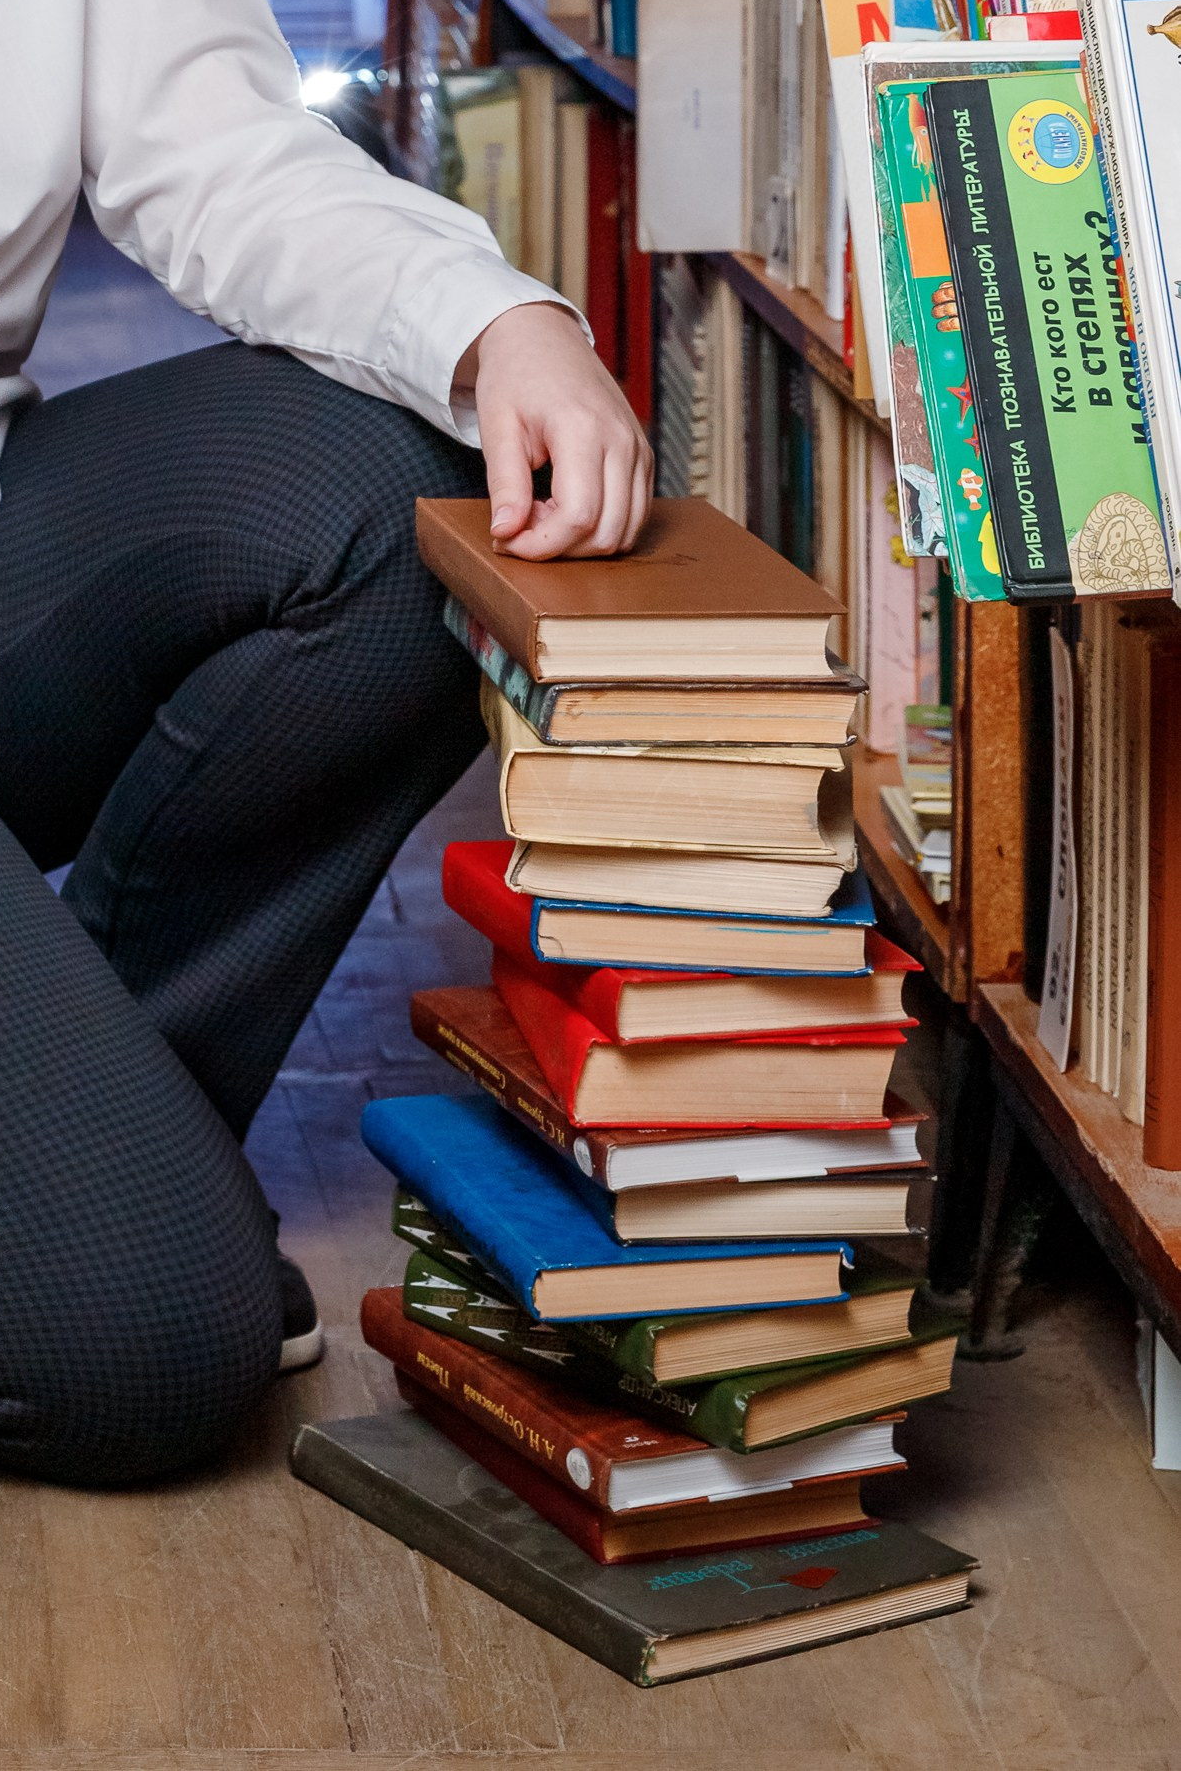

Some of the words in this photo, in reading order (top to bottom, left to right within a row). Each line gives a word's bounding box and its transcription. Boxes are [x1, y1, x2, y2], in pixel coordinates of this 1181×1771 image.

[1047, 122, 1073, 159] ПЛАНЕТА
[1064, 110, 1088, 170] ЛЮБОЗНАТЕЛЬНЫХ
[1103, 107, 1125, 210] ОКРУЖАЮЩЕГО
[953, 108, 989, 234] ЛИТЕРАТУРЫ
[1119, 211, 1130, 250] МИРА
[1033, 251, 1056, 291] ест
[1128, 265, 1141, 316] МОРЯ
[972, 243, 1022, 431] ПОЗНАВАТЕЛЬНОЙ
[1042, 298, 1068, 359] кого
[1063, 252, 1107, 376] степях
[1137, 322, 1144, 336] И
[1050, 366, 1077, 413] Кто
[1140, 341, 1157, 419] ОКЕАНЫ
[1009, 439, 1046, 570] БИБЛИОТЕКА
[1055, 694, 1068, 900] СЛОВАРИ
[416, 1350, 450, 1389] Пьесы
[462, 1383, 525, 1441] Островский
